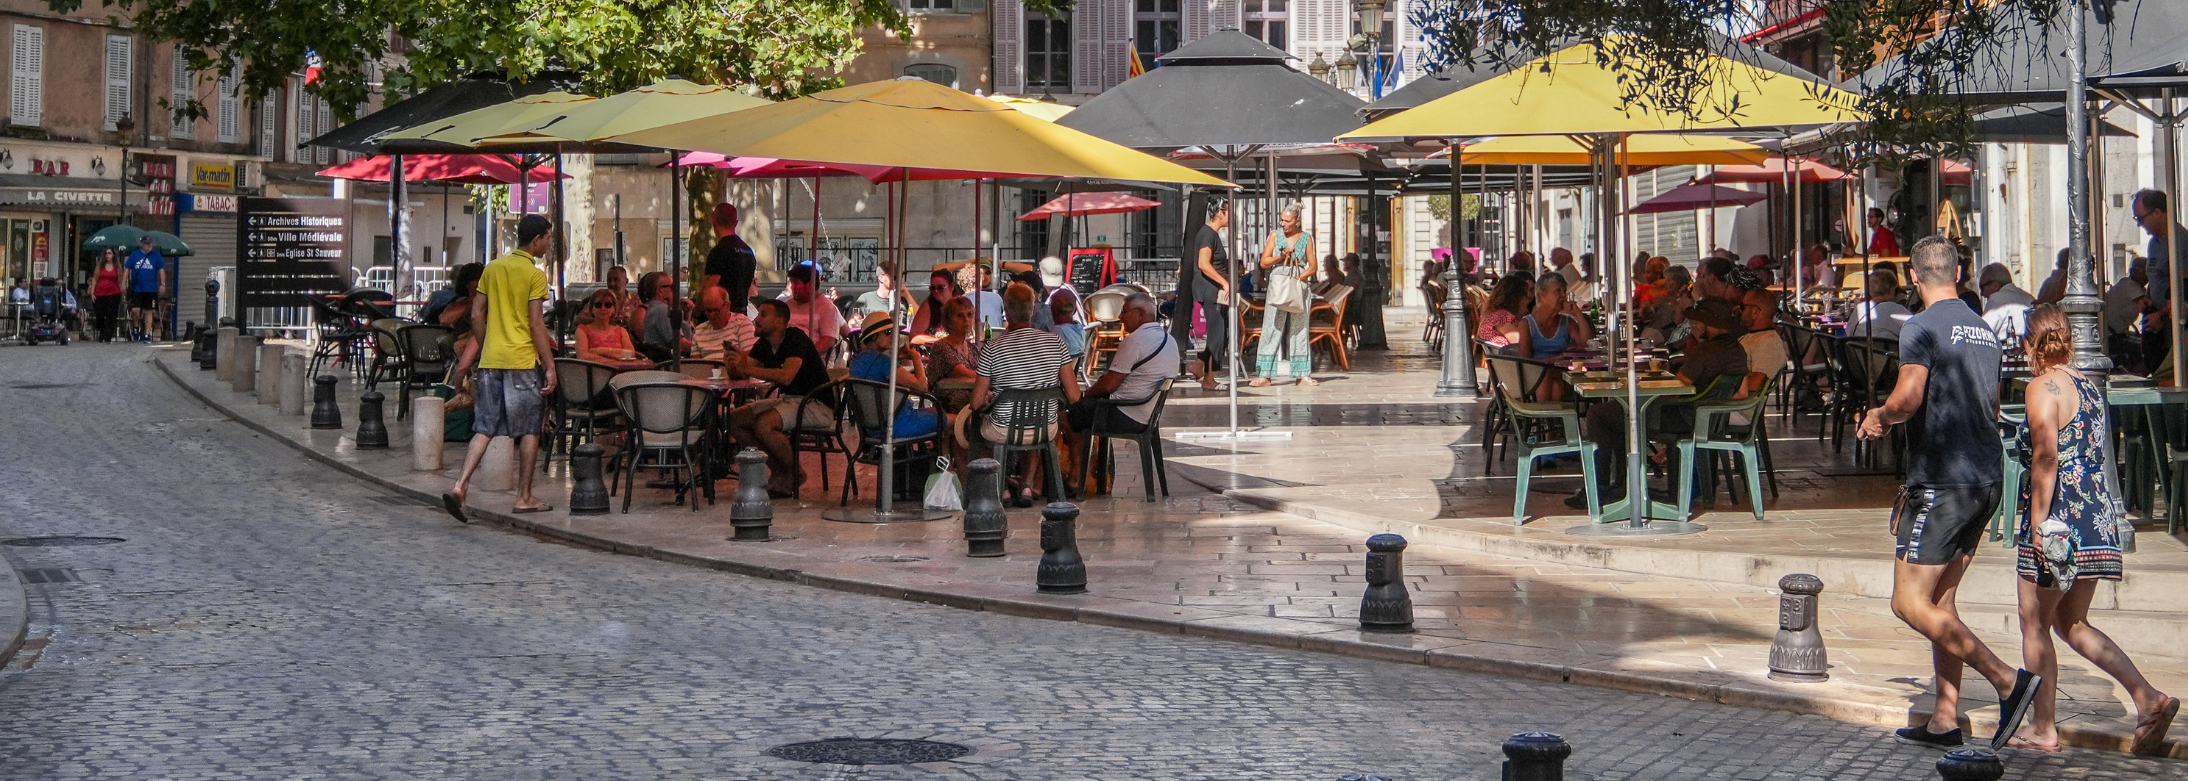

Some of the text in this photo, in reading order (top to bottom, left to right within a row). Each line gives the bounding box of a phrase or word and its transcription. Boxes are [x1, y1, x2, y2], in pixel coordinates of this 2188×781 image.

[28, 159, 69, 175] BAR
[27, 191, 111, 202] LA CIVETTE
[207, 196, 231, 211] TABAC
[267, 216, 342, 227] Archives Historiques
[278, 232, 297, 241] Ville
[299, 232, 342, 241] Médiévale
[285, 248, 305, 259] Eglise
[306, 248, 314, 257] St
[315, 248, 342, 257] Sauveur
